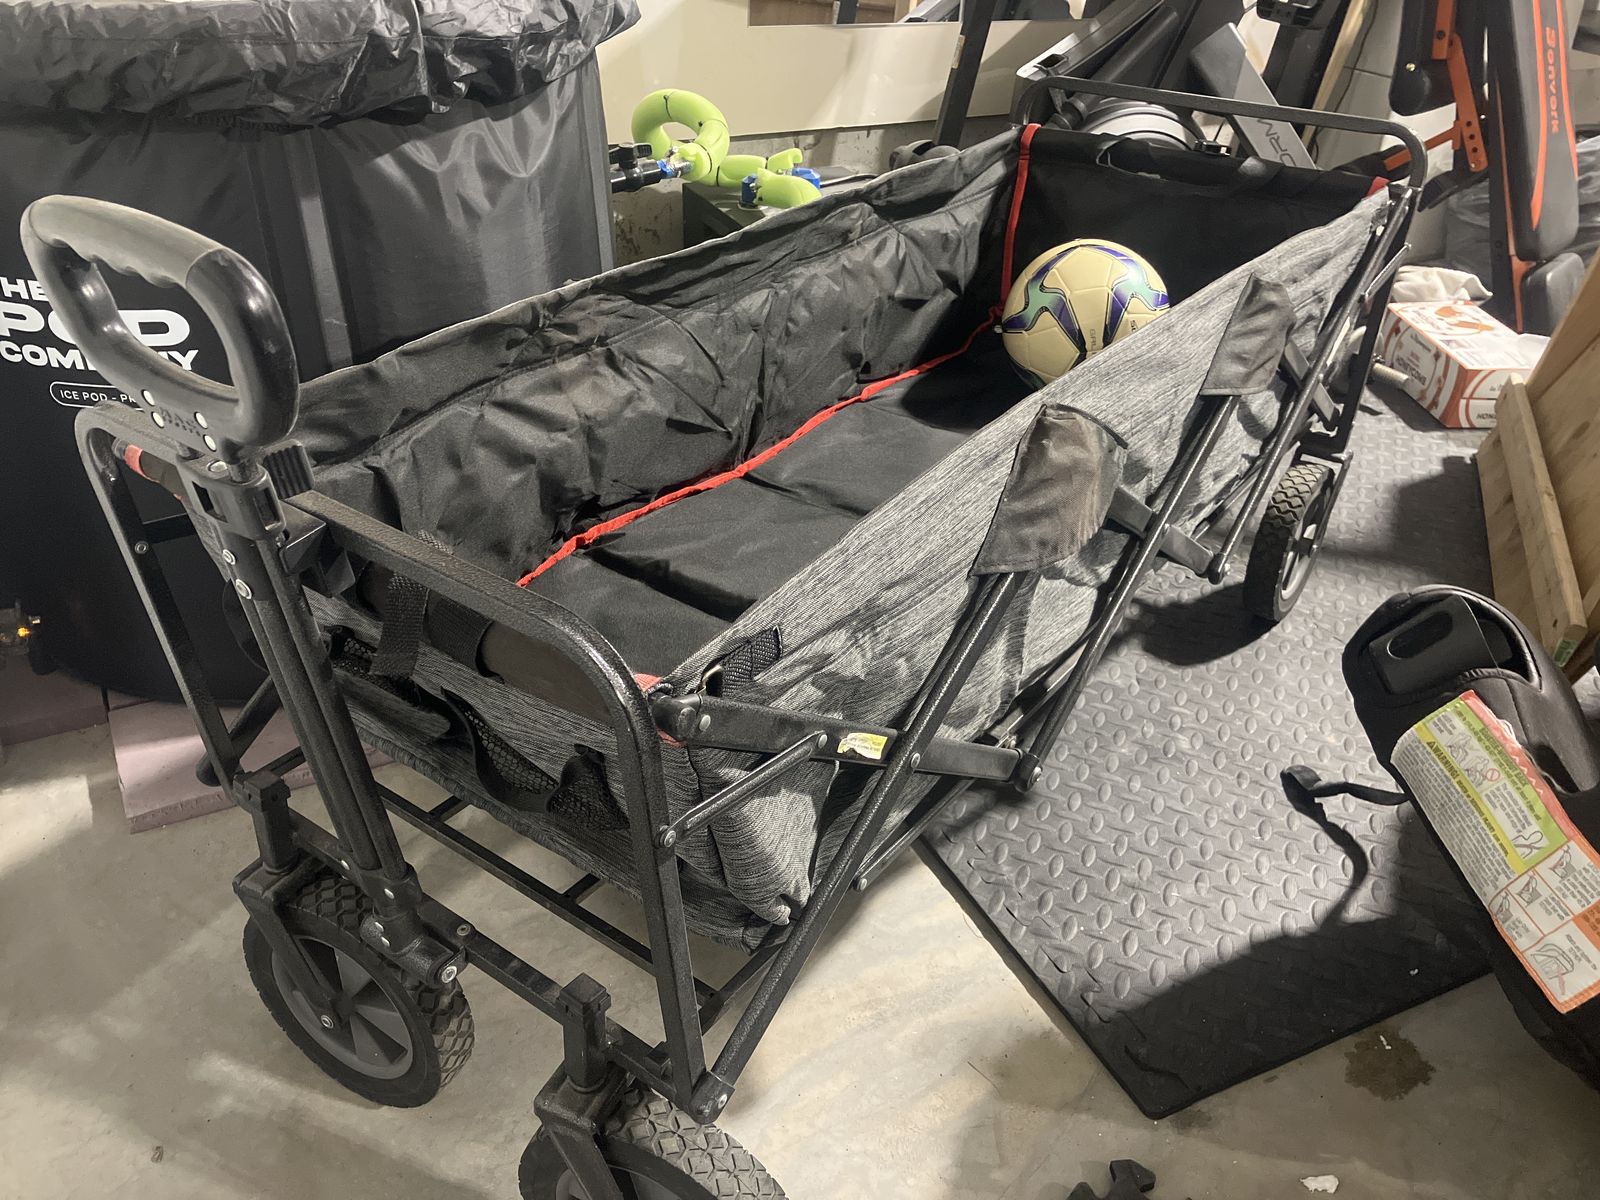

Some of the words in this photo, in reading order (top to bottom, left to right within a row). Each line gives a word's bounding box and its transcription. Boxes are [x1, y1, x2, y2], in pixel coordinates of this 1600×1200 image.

[0, 340, 199, 371] COMY
[60, 389, 79, 400] ICE
[82, 392, 107, 402] POD
